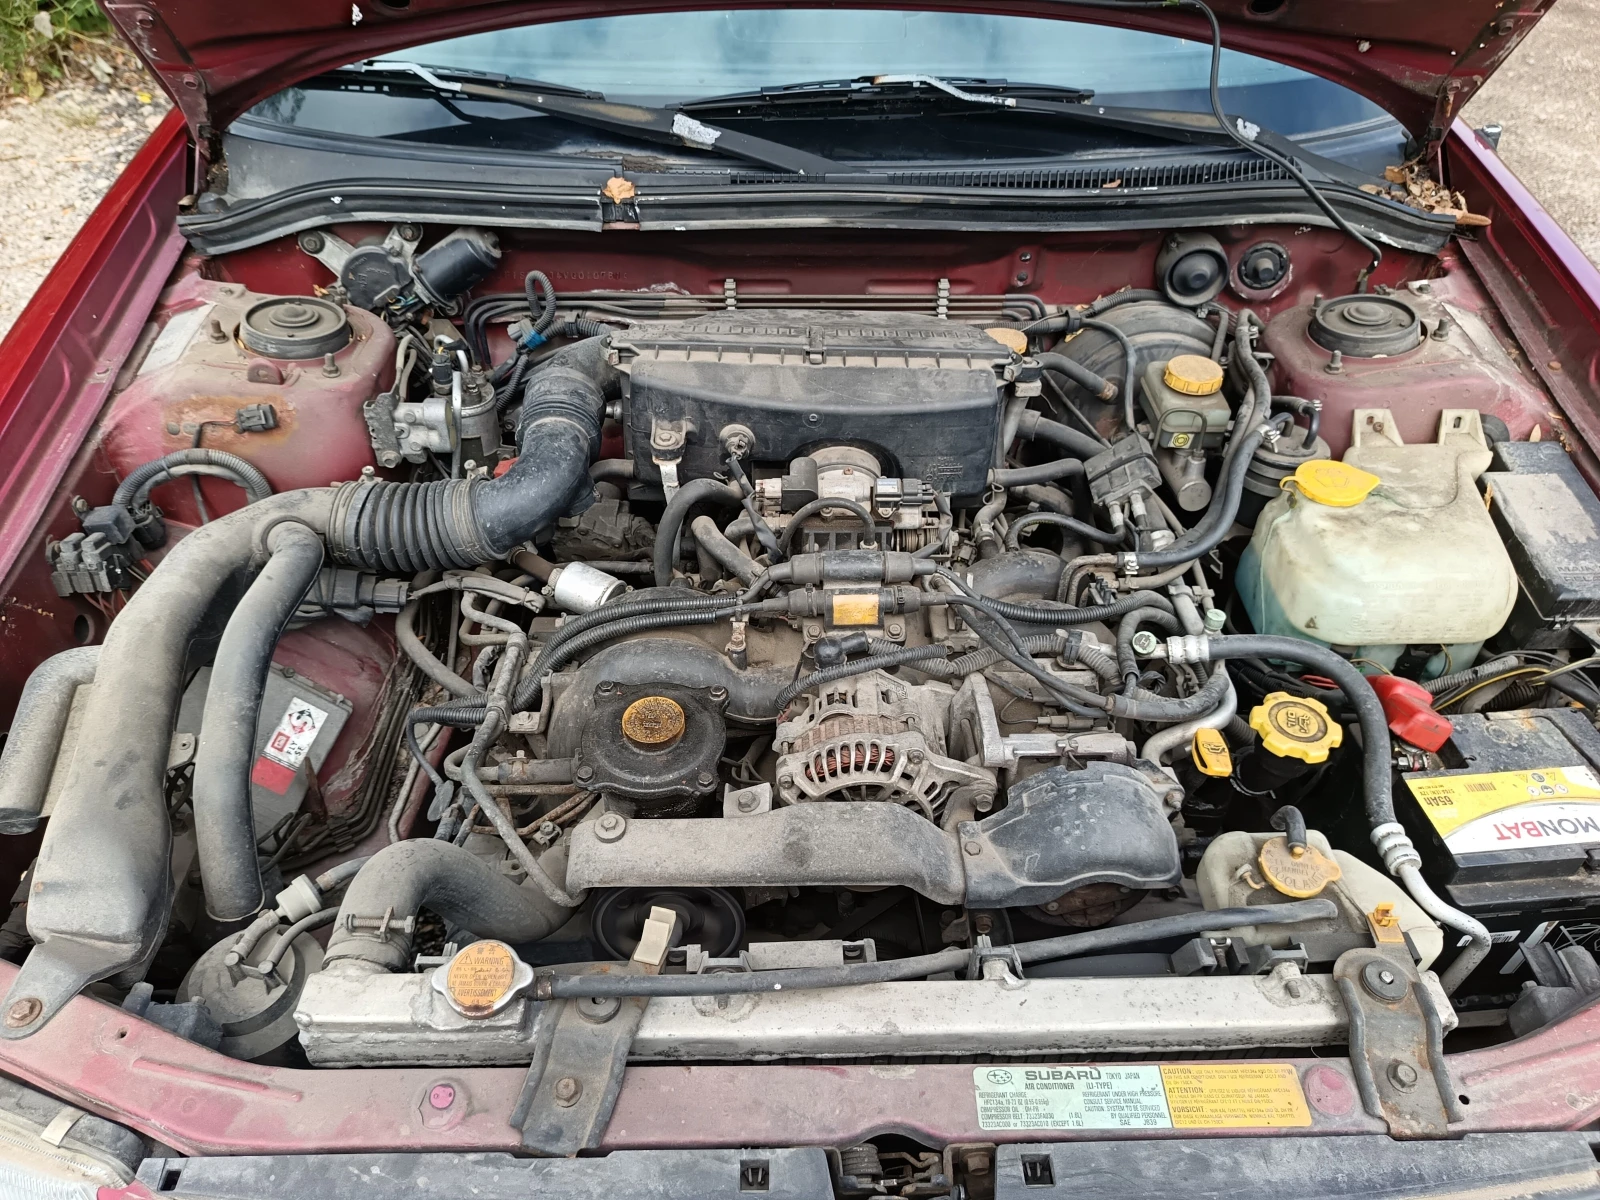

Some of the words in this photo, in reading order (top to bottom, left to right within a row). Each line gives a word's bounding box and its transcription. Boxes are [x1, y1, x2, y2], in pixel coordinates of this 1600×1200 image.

[1286, 711, 1297, 728] OIL
[1423, 795, 1454, 807] 65Ah
[1493, 816, 1600, 841] MONBAT
[474, 957, 504, 965] WARNING
[1025, 1070, 1102, 1080] SUBARU
[1105, 1072, 1121, 1080] TOKYO
[1125, 1072, 1140, 1080] JAPAN
